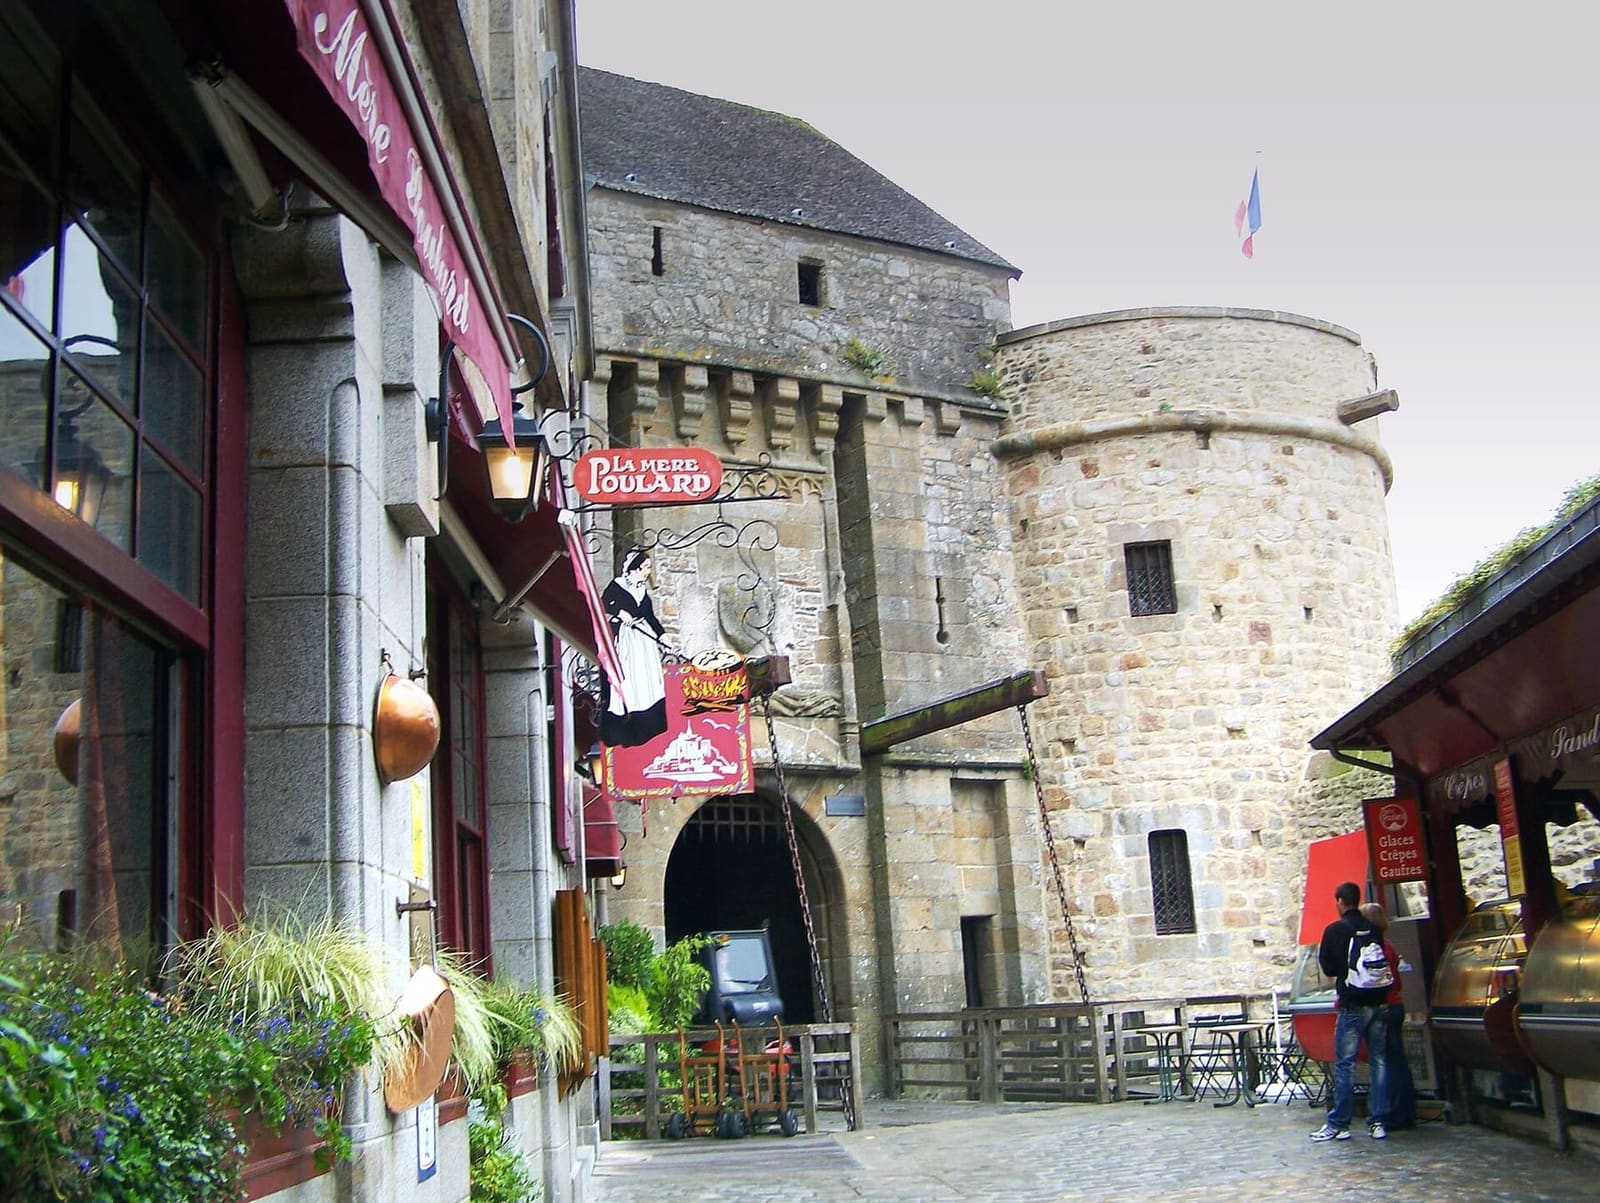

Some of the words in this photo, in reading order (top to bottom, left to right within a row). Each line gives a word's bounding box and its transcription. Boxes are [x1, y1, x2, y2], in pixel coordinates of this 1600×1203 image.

[612, 455, 636, 472] LA
[640, 458, 699, 473] MERE
[587, 456, 712, 497] POULARD
[1379, 834, 1415, 848] Glaces
[1379, 863, 1423, 878] Gaufres
